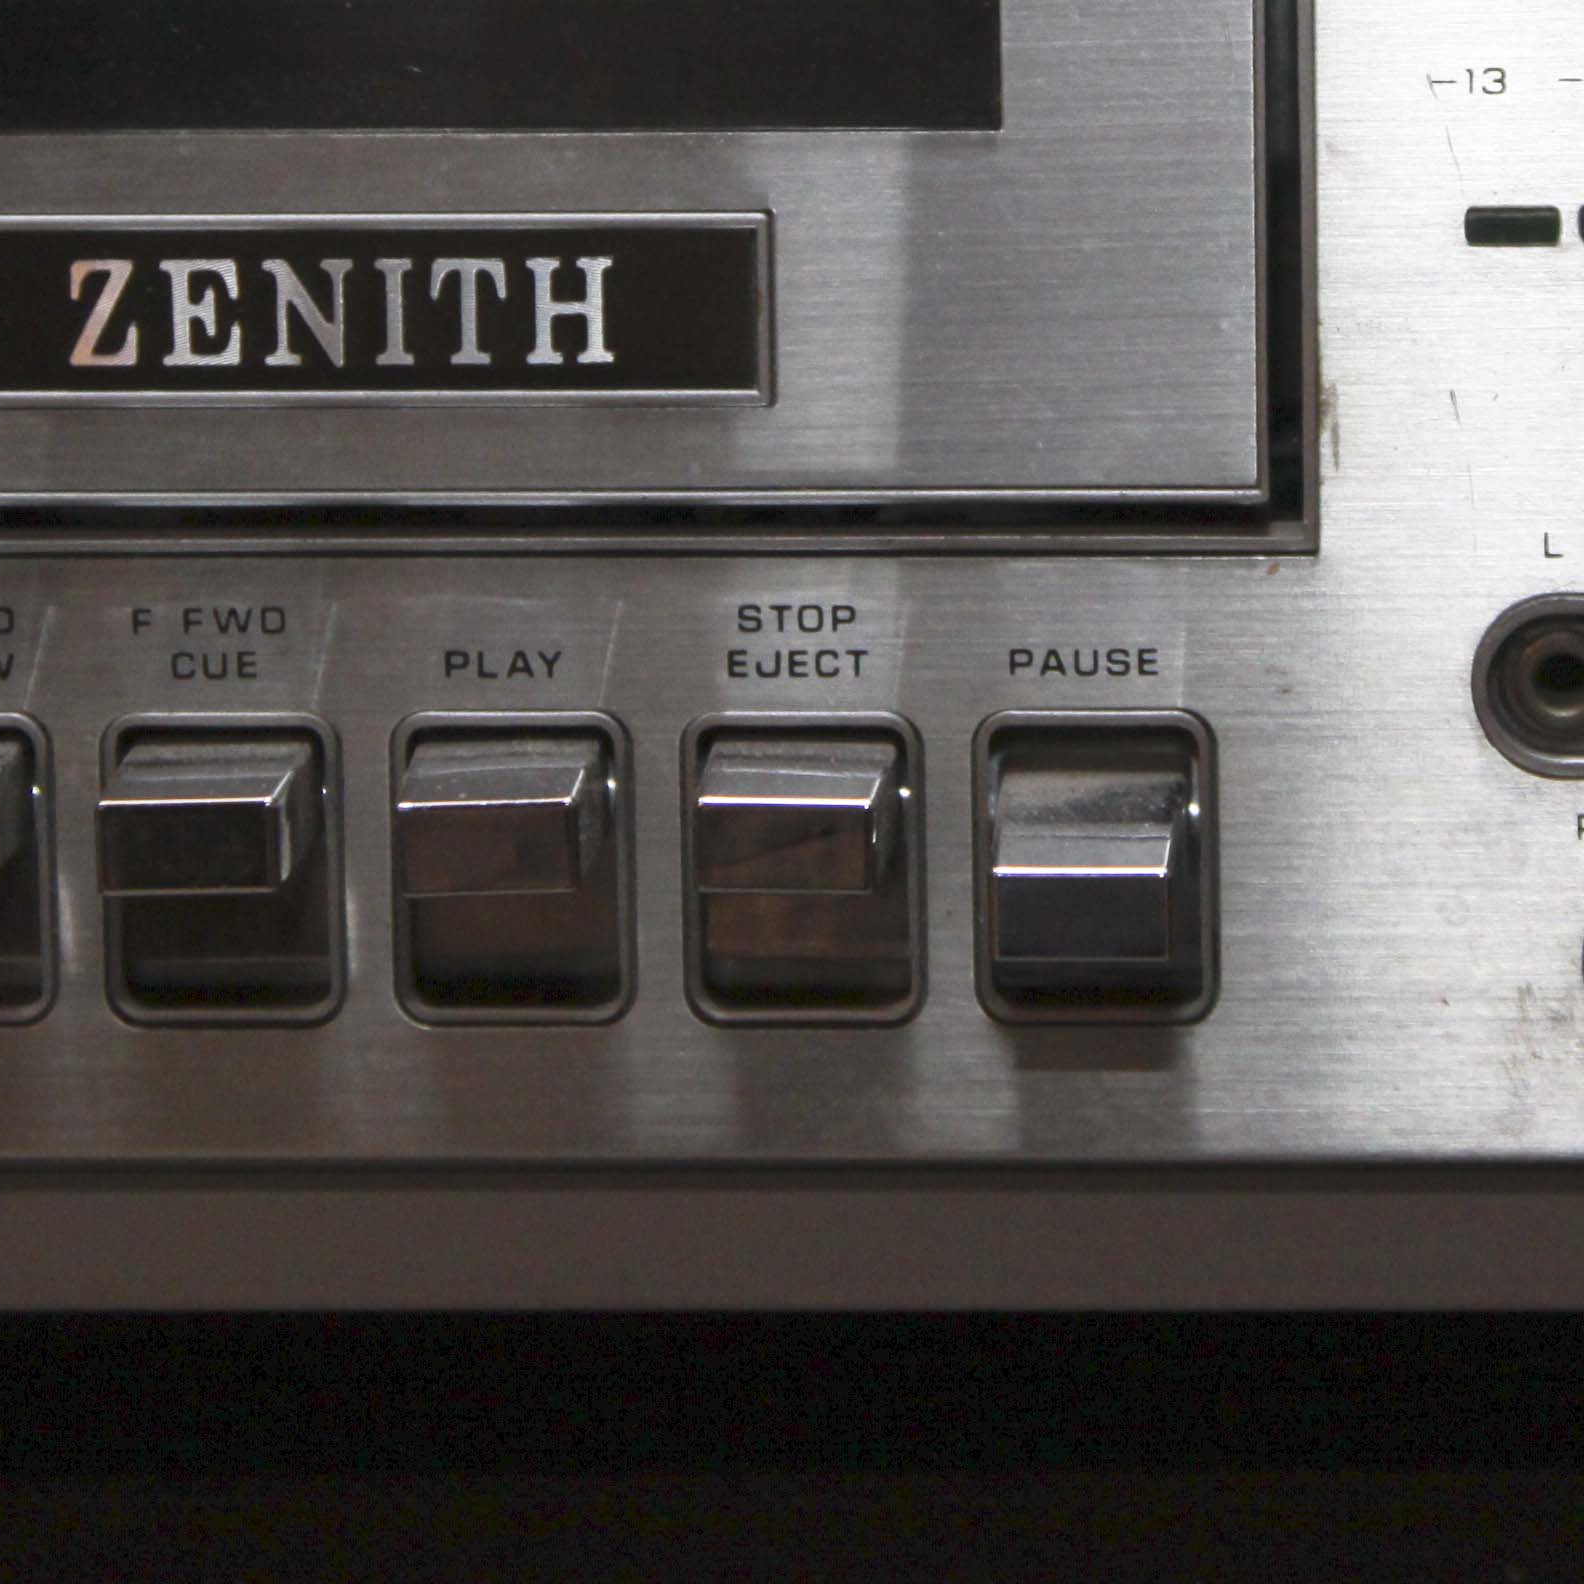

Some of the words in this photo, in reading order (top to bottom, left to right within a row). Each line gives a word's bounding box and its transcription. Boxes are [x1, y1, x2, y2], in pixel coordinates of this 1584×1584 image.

[69, 258, 615, 367] ZENITH
[1542, 531, 1564, 560] L
[131, 607, 152, 635] F
[182, 605, 288, 635] FWD
[736, 604, 858, 634] STOP
[170, 649, 260, 680] CUE
[444, 650, 564, 678] PLAY
[726, 648, 870, 679] EJECT
[1008, 648, 1162, 677] PAUSE
